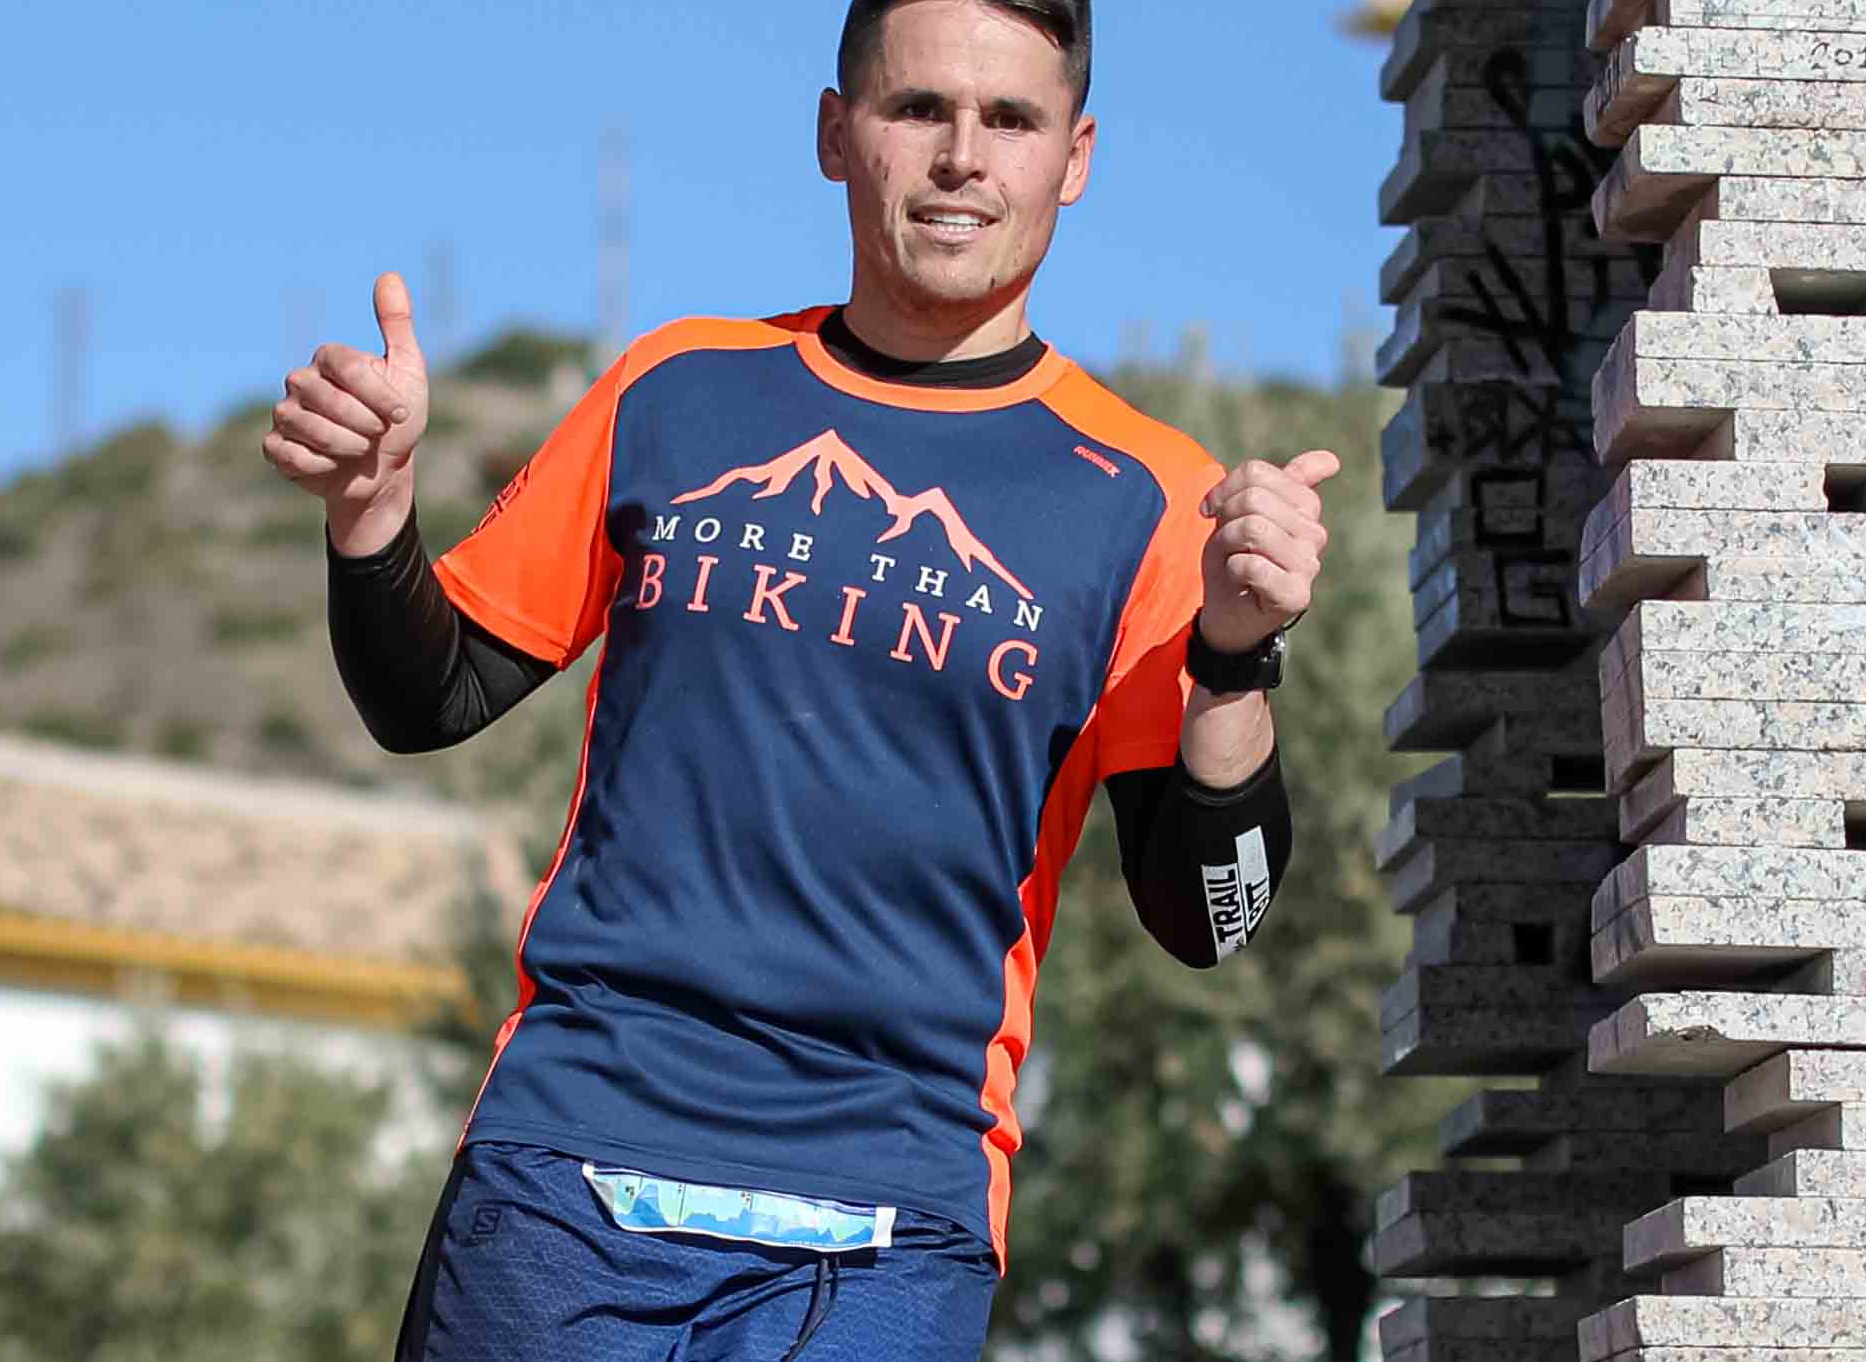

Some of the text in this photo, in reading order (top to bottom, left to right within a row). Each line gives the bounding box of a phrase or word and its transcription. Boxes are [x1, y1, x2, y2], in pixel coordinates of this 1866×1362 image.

[635, 553, 1039, 702] BIKING
[652, 515, 1044, 632] MORE THAN
[1206, 868, 1245, 944] TRAIL
